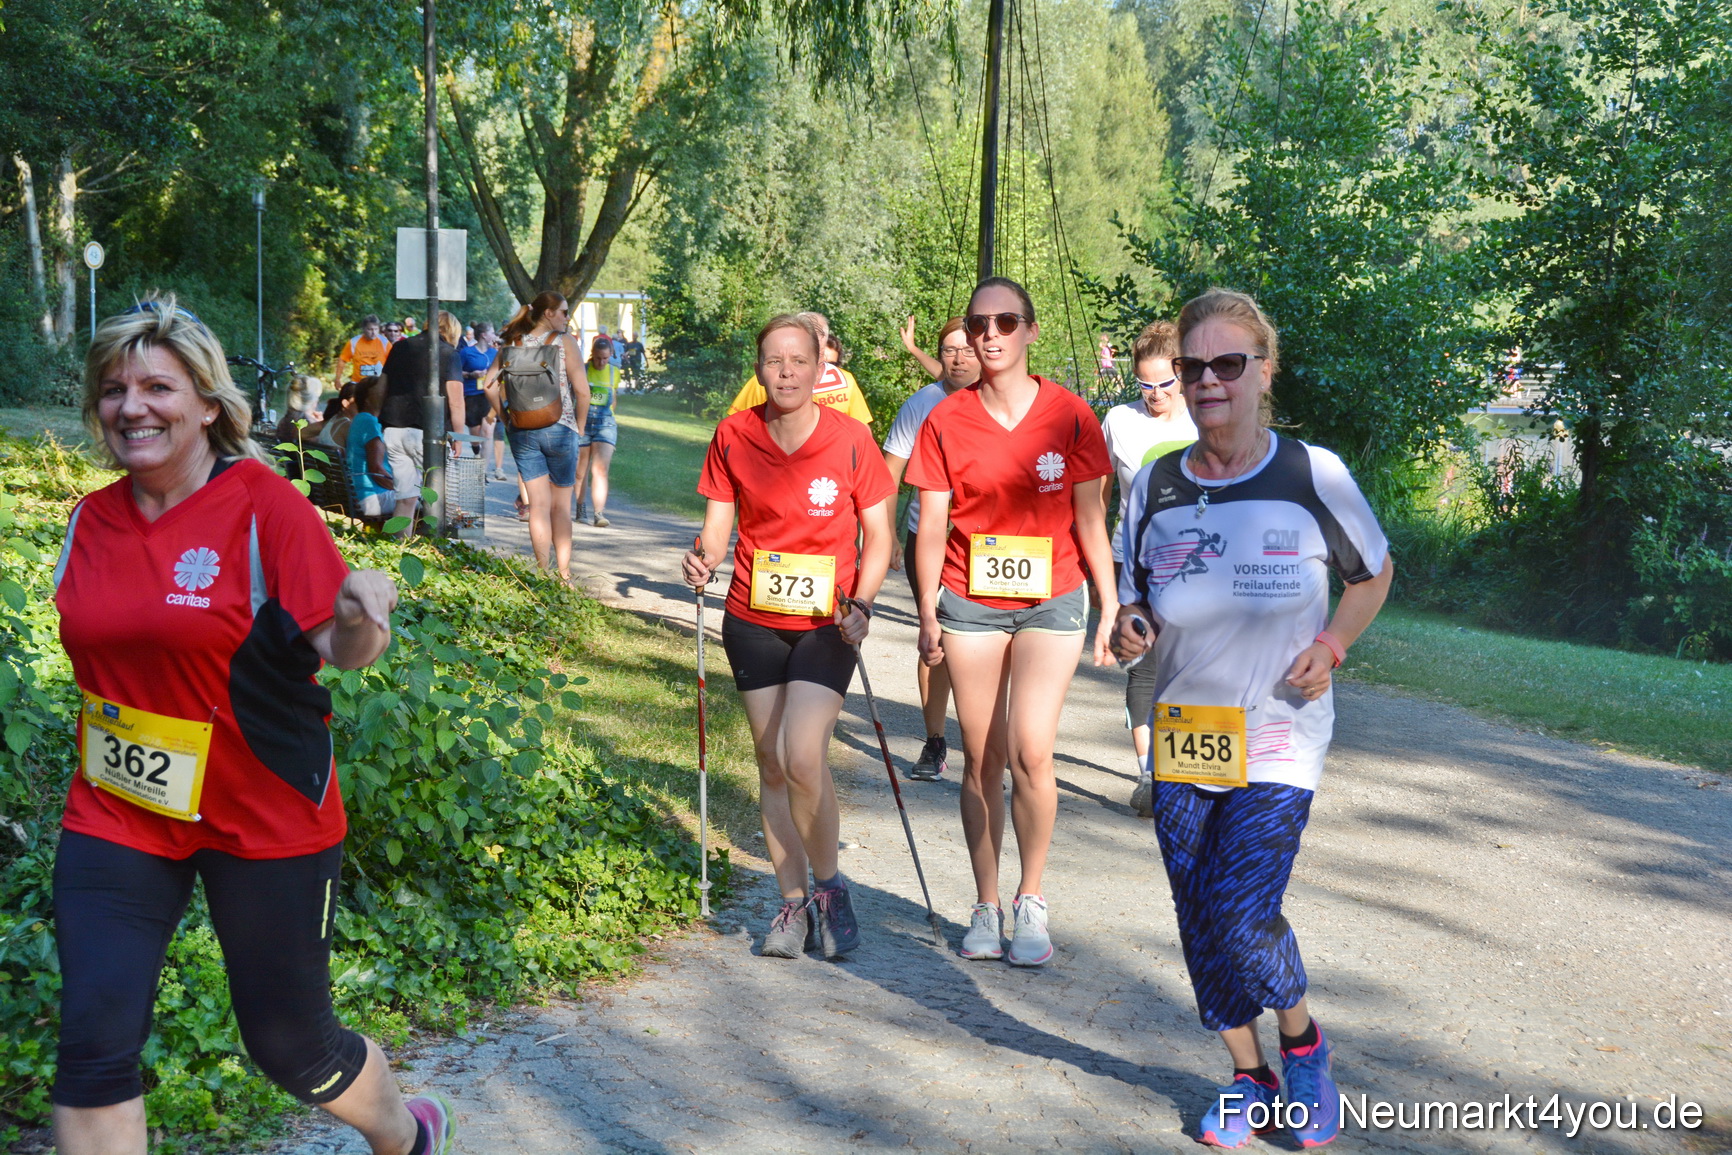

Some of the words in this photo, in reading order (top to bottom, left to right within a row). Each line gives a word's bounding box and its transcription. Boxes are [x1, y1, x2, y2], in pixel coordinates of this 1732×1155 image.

[818, 393, 848, 406] BÖGL
[1038, 482, 1064, 493] caritas
[807, 508, 835, 517] caritas
[986, 557, 1031, 580] 360
[1233, 564, 1300, 575] VORSICHT!
[768, 573, 814, 598] 373
[1233, 580, 1301, 590] Freilaufende
[166, 592, 211, 608] caritas
[766, 595, 786, 603] Simon
[787, 598, 816, 606] Christine
[1164, 732, 1232, 762] 1458
[103, 735, 171, 786] 362
[1177, 761, 1200, 769] Mundt
[1201, 763, 1222, 771] Elvira
[105, 767, 132, 785] Nüßler
[133, 780, 166, 797] Mireille
